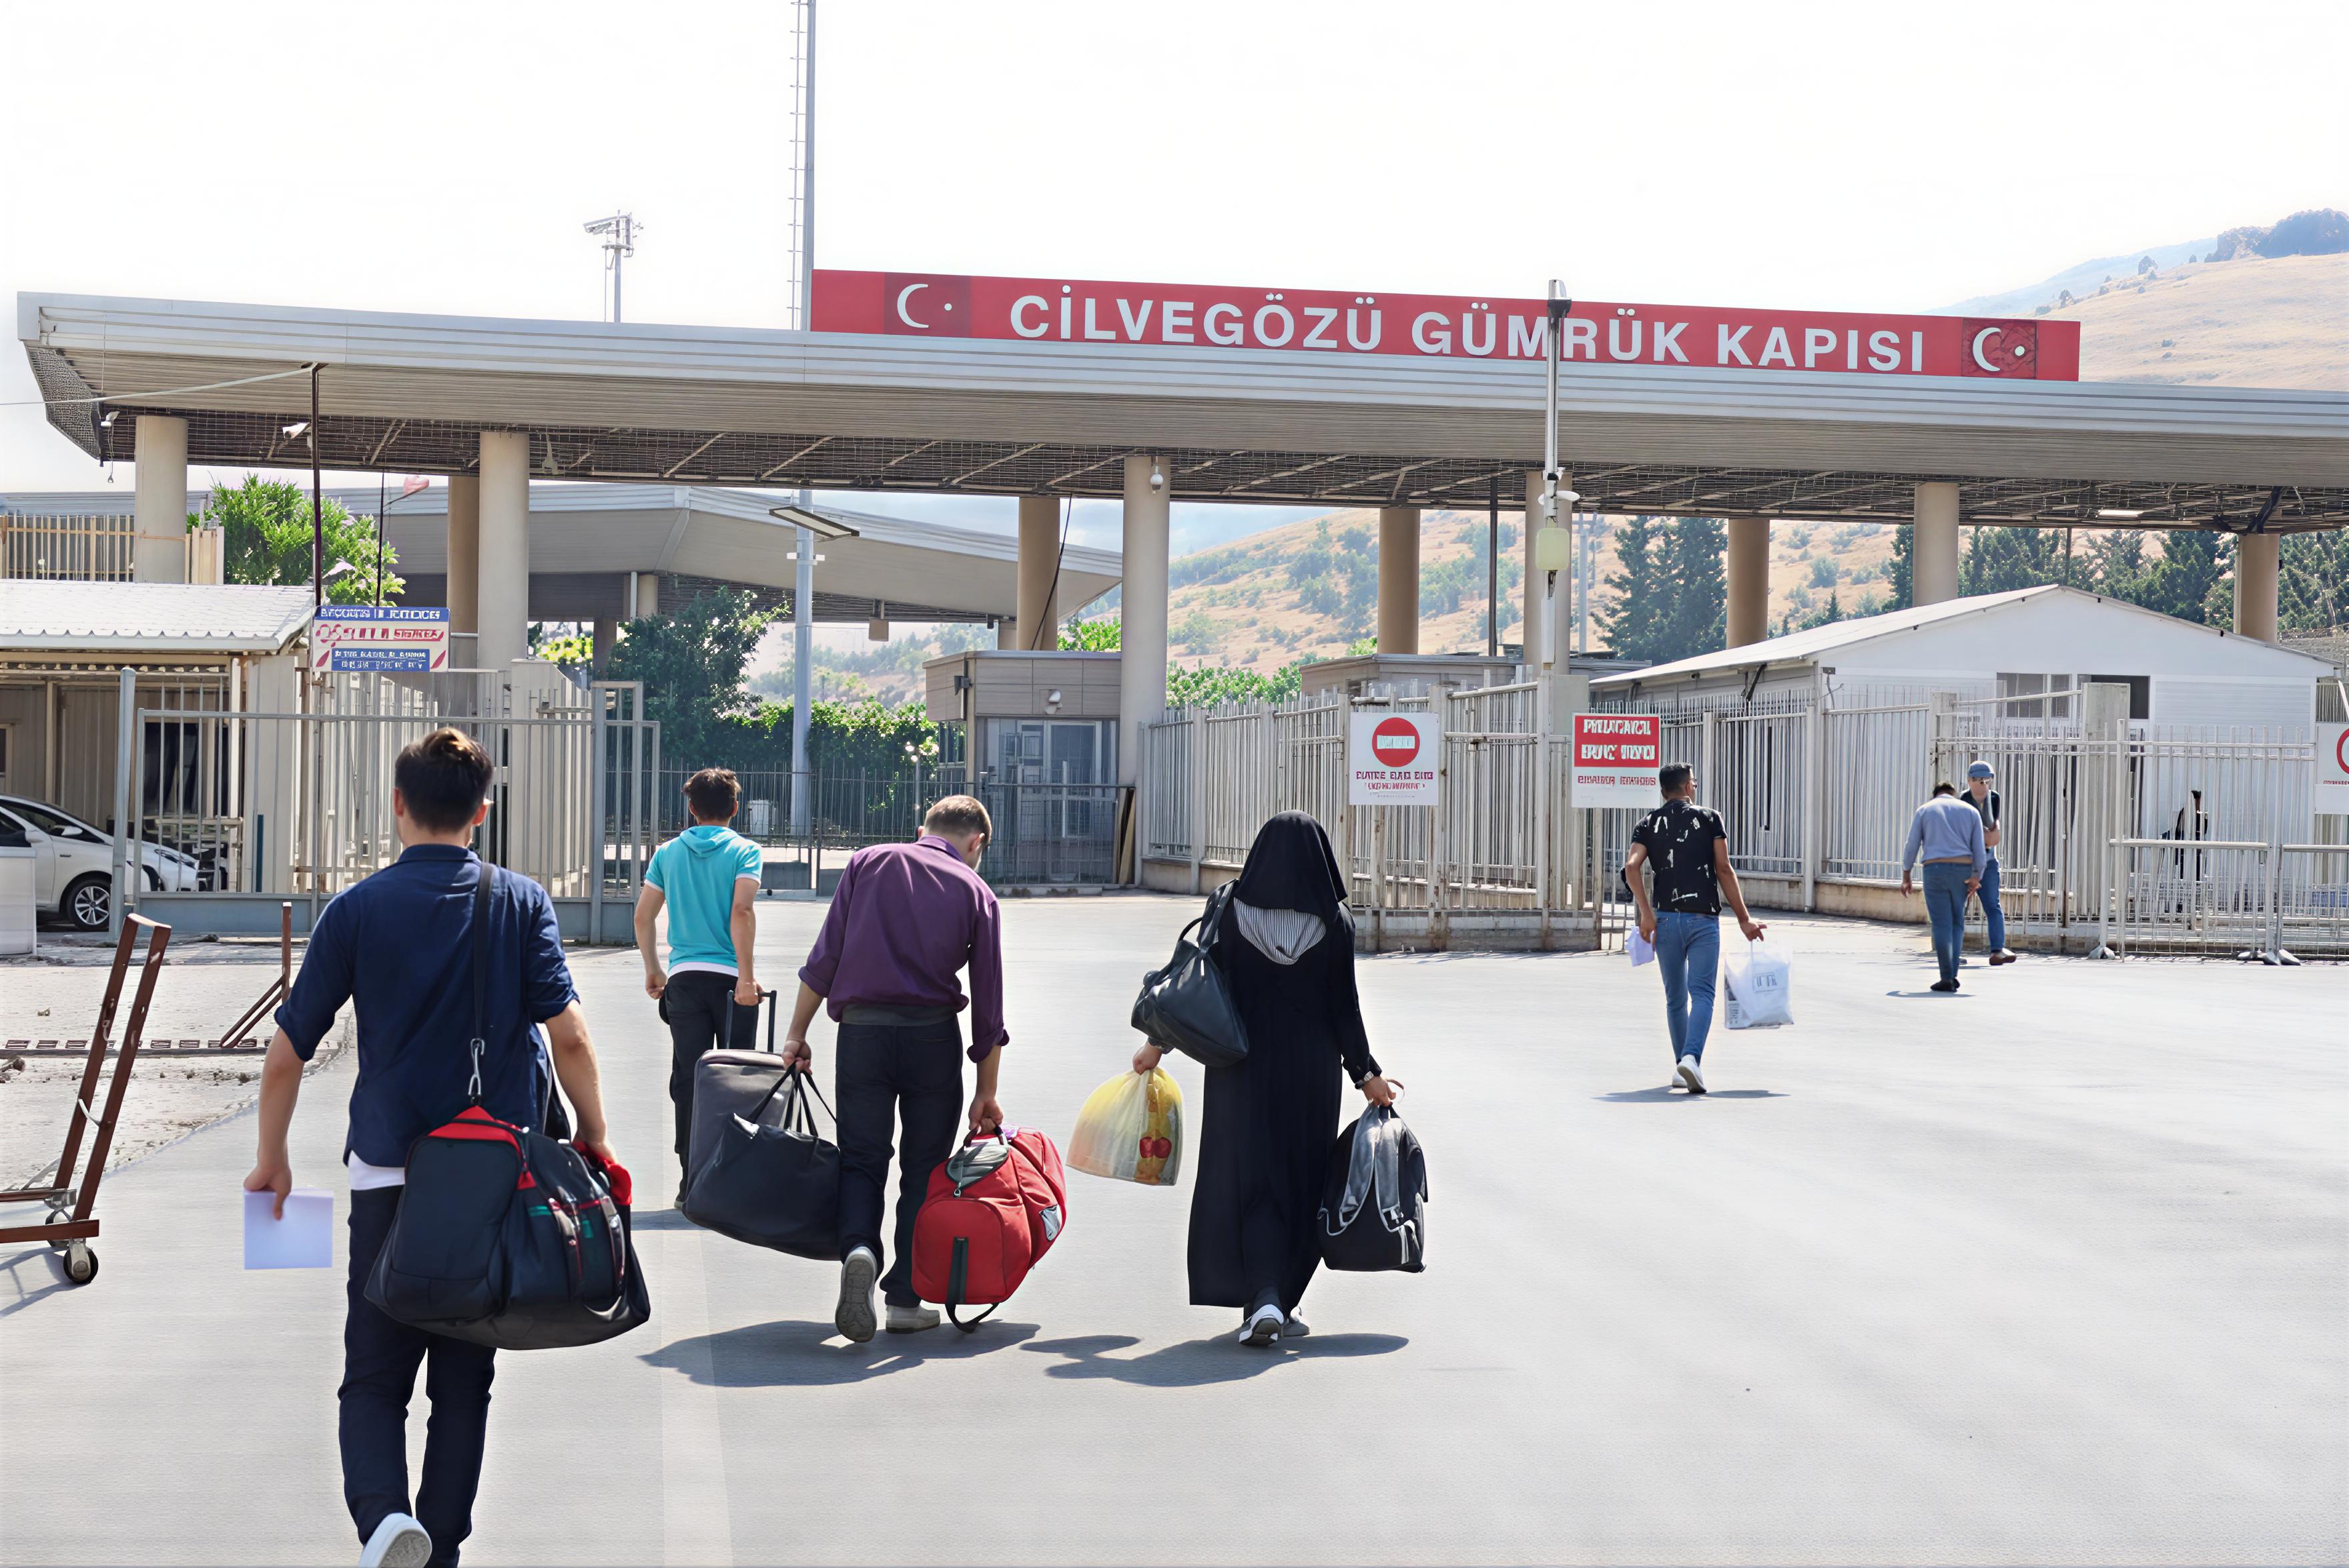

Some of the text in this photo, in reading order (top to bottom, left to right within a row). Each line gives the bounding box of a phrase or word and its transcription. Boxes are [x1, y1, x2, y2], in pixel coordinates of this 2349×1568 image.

[1010, 284, 1923, 372] CİLVEGÖZÜ GÜMRÜK KAPISI
